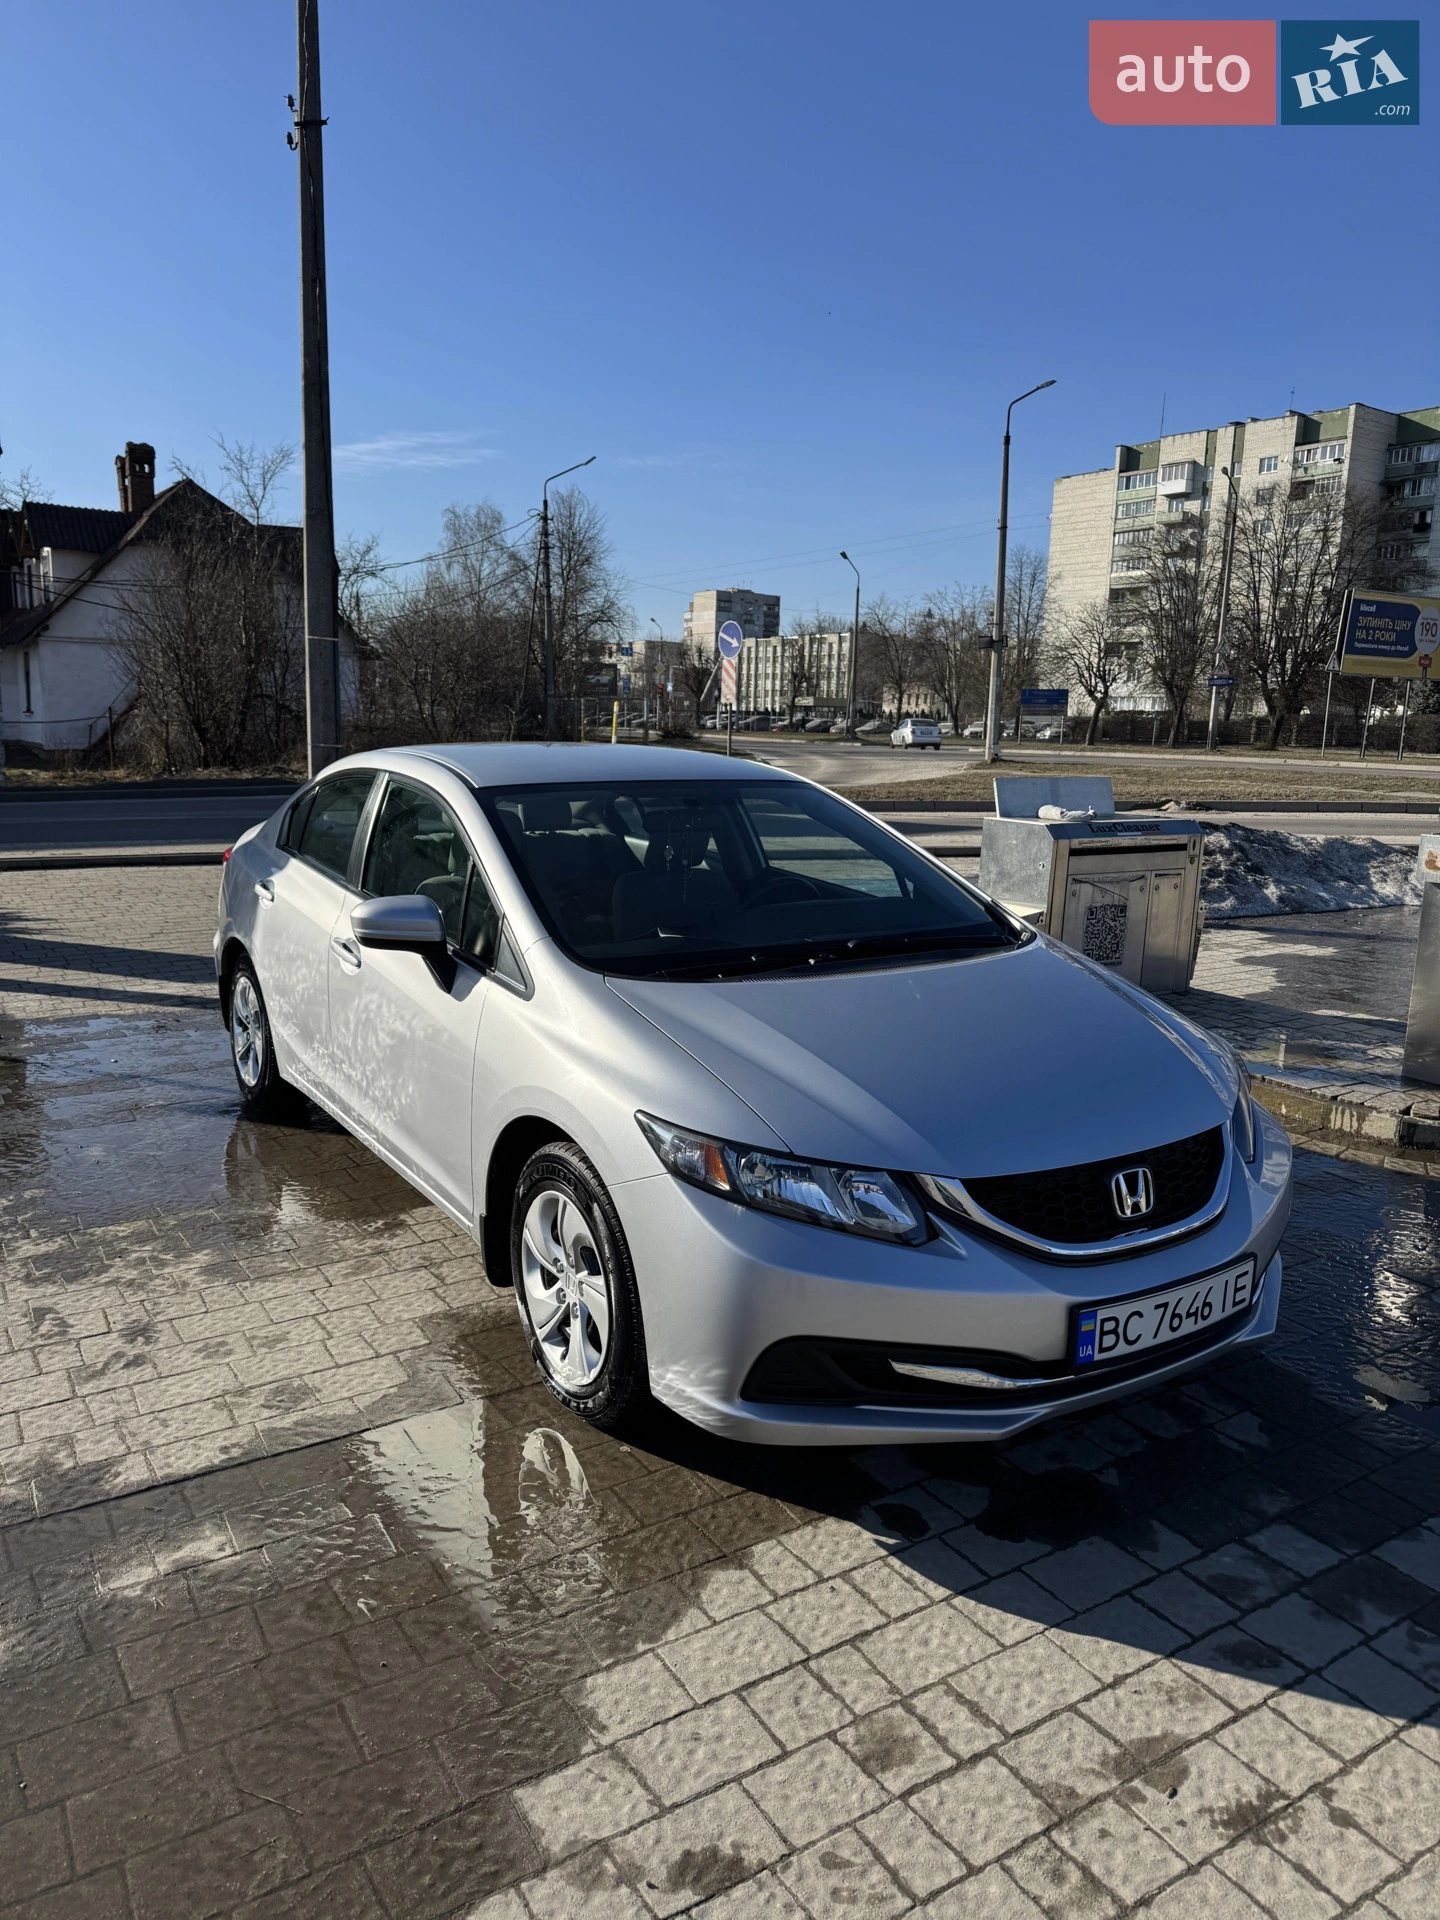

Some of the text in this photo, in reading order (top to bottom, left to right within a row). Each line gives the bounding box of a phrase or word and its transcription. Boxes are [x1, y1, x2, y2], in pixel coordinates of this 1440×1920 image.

[1360, 604, 1376, 612] lifecell
[1357, 616, 1412, 631] ЗУПИНІТЬ ЦІНУ
[1420, 621, 1438, 638] 190
[1355, 629, 1397, 642] НА 2 РОКИ
[1087, 822, 1161, 834] LuxCleaner
[1097, 1269, 1250, 1354] BC 7646 IE
[1079, 1345, 1093, 1357] UA
